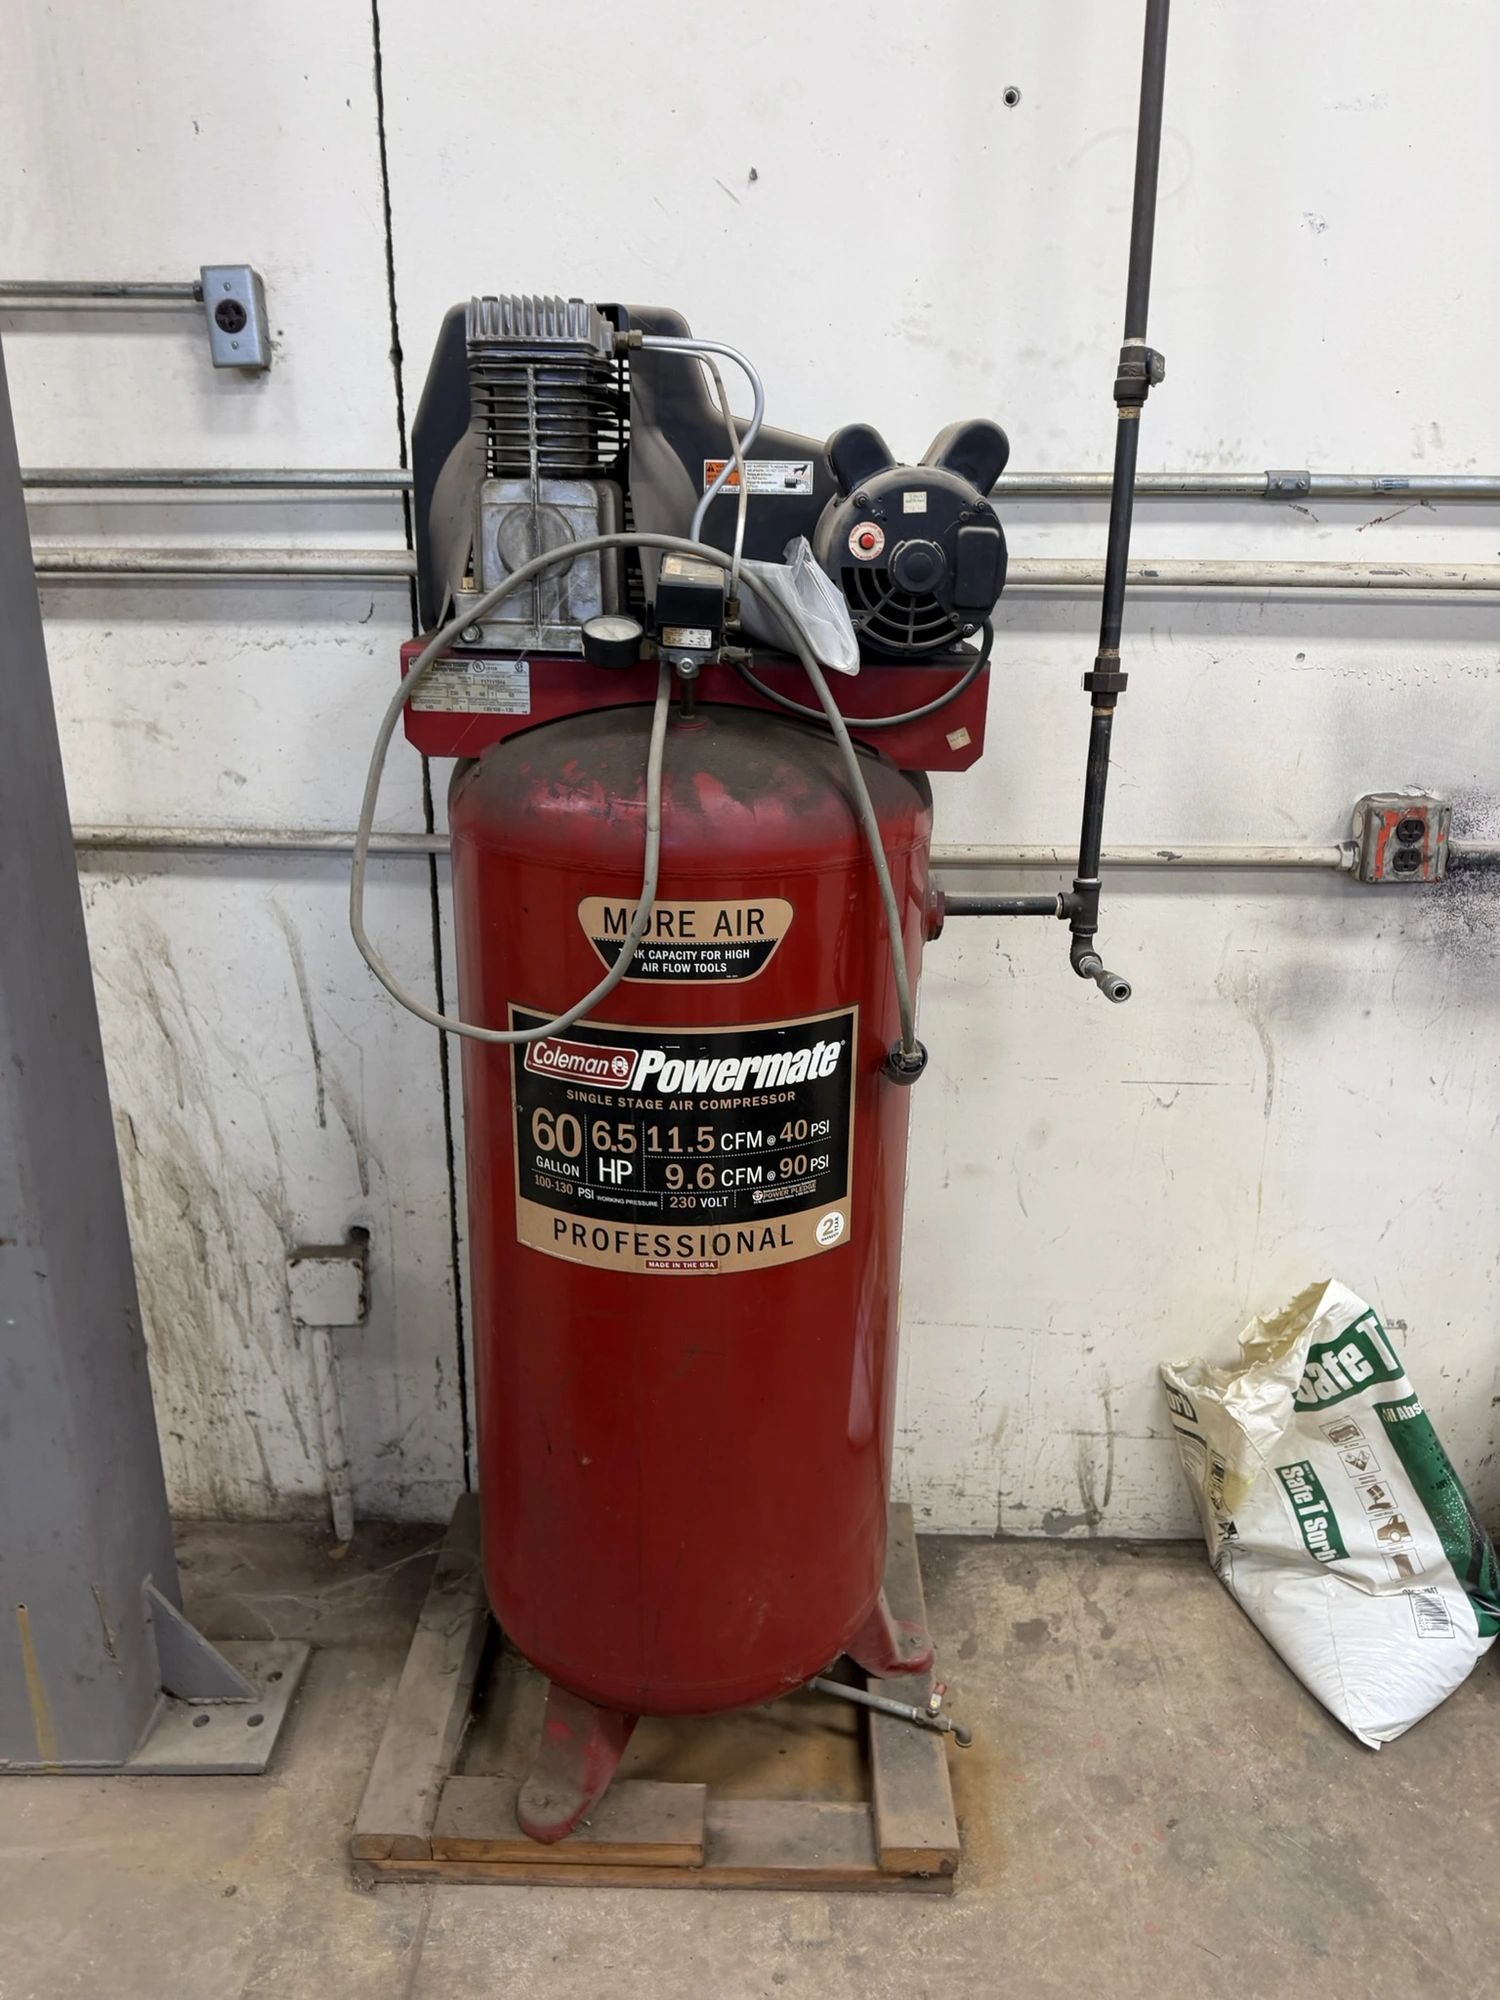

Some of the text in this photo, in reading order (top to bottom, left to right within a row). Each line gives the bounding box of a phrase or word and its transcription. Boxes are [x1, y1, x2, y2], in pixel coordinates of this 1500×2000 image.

[713, 909, 765, 938] AIR
[641, 962, 728, 973] AIR FLOW TOOLS
[648, 949, 698, 961] CAPACITY
[700, 950, 721, 960] FOR
[724, 949, 750, 959] HIGH
[532, 1040, 842, 1094] Coleman Powermate
[566, 1089, 796, 1111] SINGLE STAGE AIR COMPRESSOR
[532, 1106, 583, 1158] 60
[592, 1120, 638, 1154] 6.5
[647, 1119, 831, 1153] 11.5 CFM @ 40 PSI
[535, 1155, 580, 1178] GALLON
[598, 1156, 633, 1185] HP
[665, 1163, 716, 1190] 9.6
[721, 1165, 763, 1187] CFM
[766, 1169, 777, 1182] @
[779, 1154, 808, 1179] 90
[810, 1154, 830, 1173] PSI
[534, 1174, 659, 1208] 100-130 PSI WORKING PRESSURE
[669, 1196, 729, 1209] 230 VOLT
[763, 1189, 789, 1200] POWER
[791, 1182, 817, 1195] PLEDGE
[553, 1217, 794, 1258] PROFESSIONAL
[822, 1218, 834, 1237] 2
[648, 1261, 715, 1269] MADE IN THE USA
[1355, 1315, 1399, 1371] T
[1396, 1401, 1424, 1421] Abs
[1280, 1465, 1338, 1562] Safe T Sorb
